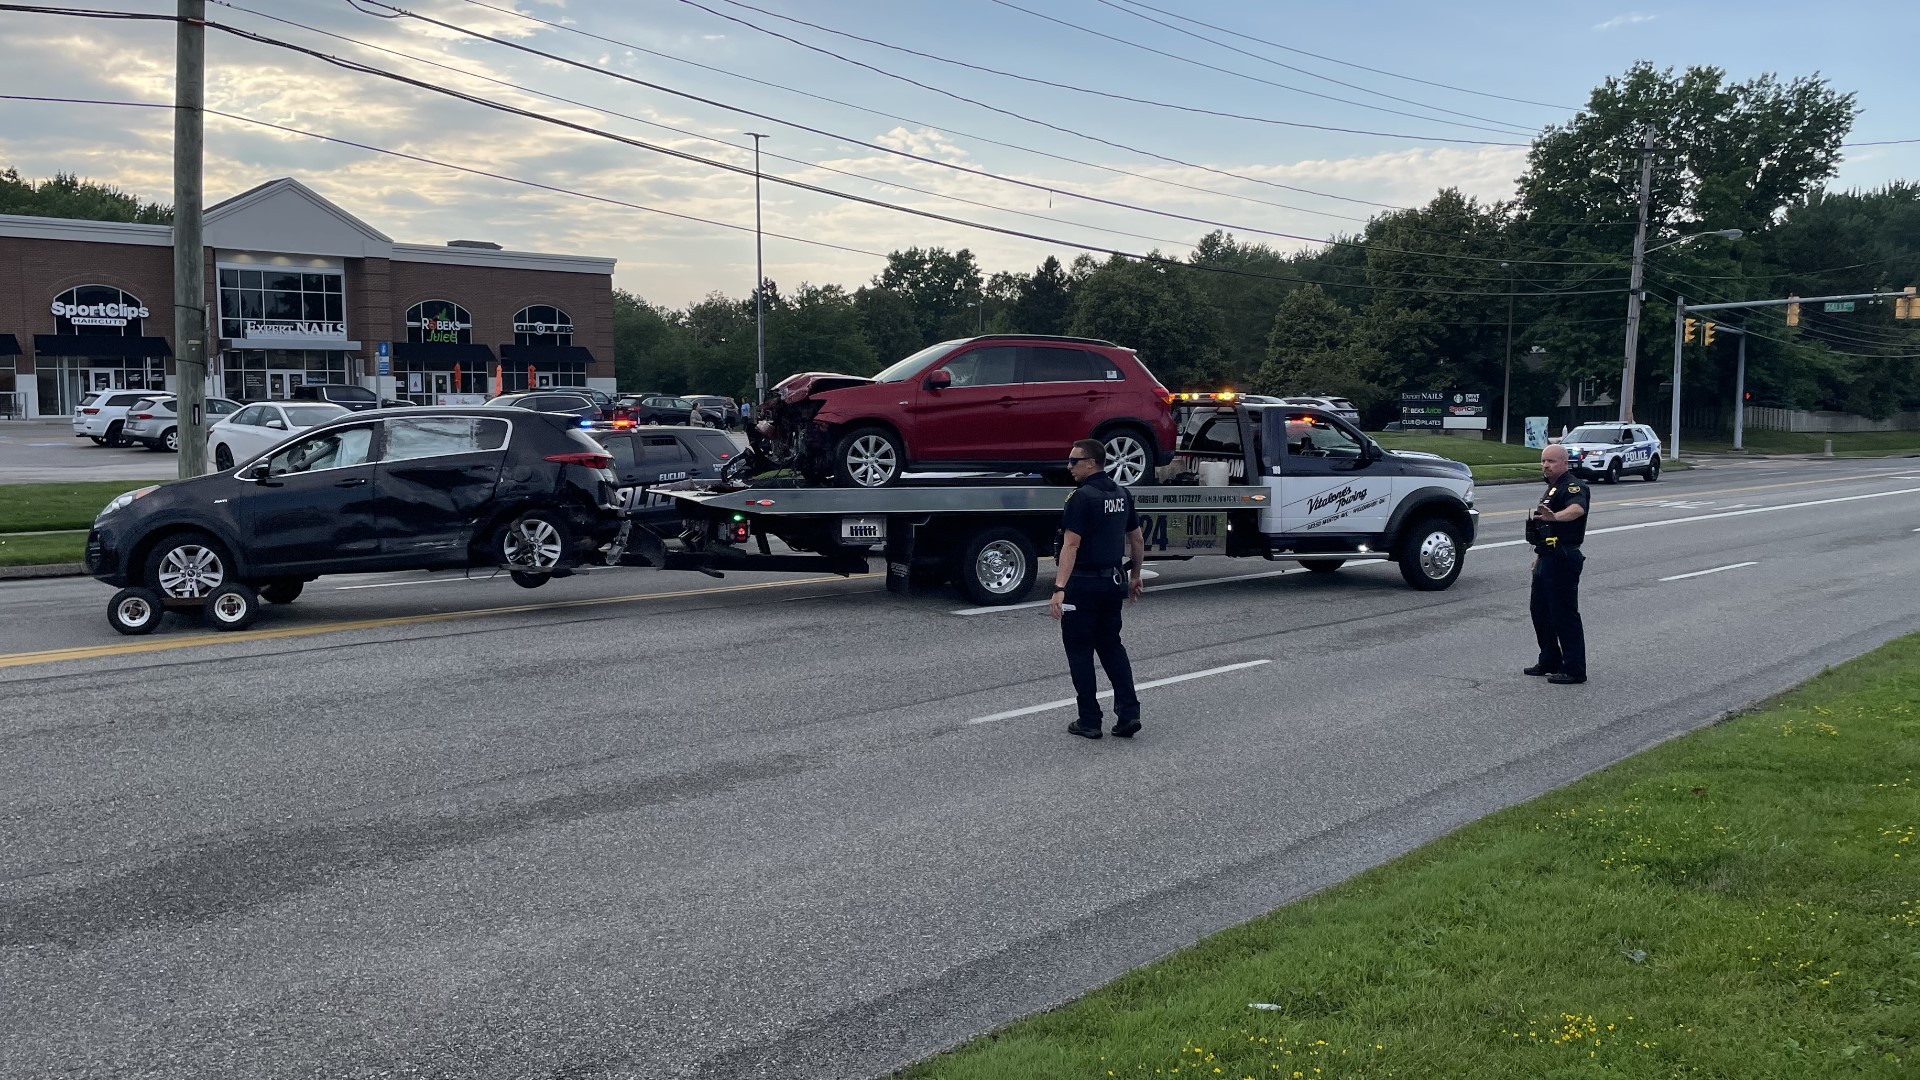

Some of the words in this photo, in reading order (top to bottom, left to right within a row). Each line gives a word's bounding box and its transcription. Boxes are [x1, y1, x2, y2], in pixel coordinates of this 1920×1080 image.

[51, 302, 149, 320] SportClips
[296, 323, 347, 335] NAILS
[1422, 392, 1443, 400] NAILS
[1625, 450, 1648, 461] POLICE
[659, 472, 686, 480] EUCLID
[1104, 498, 1125, 513] POLICE
[1139, 514, 1168, 551] 24
[1187, 514, 1217, 535] HOUR
